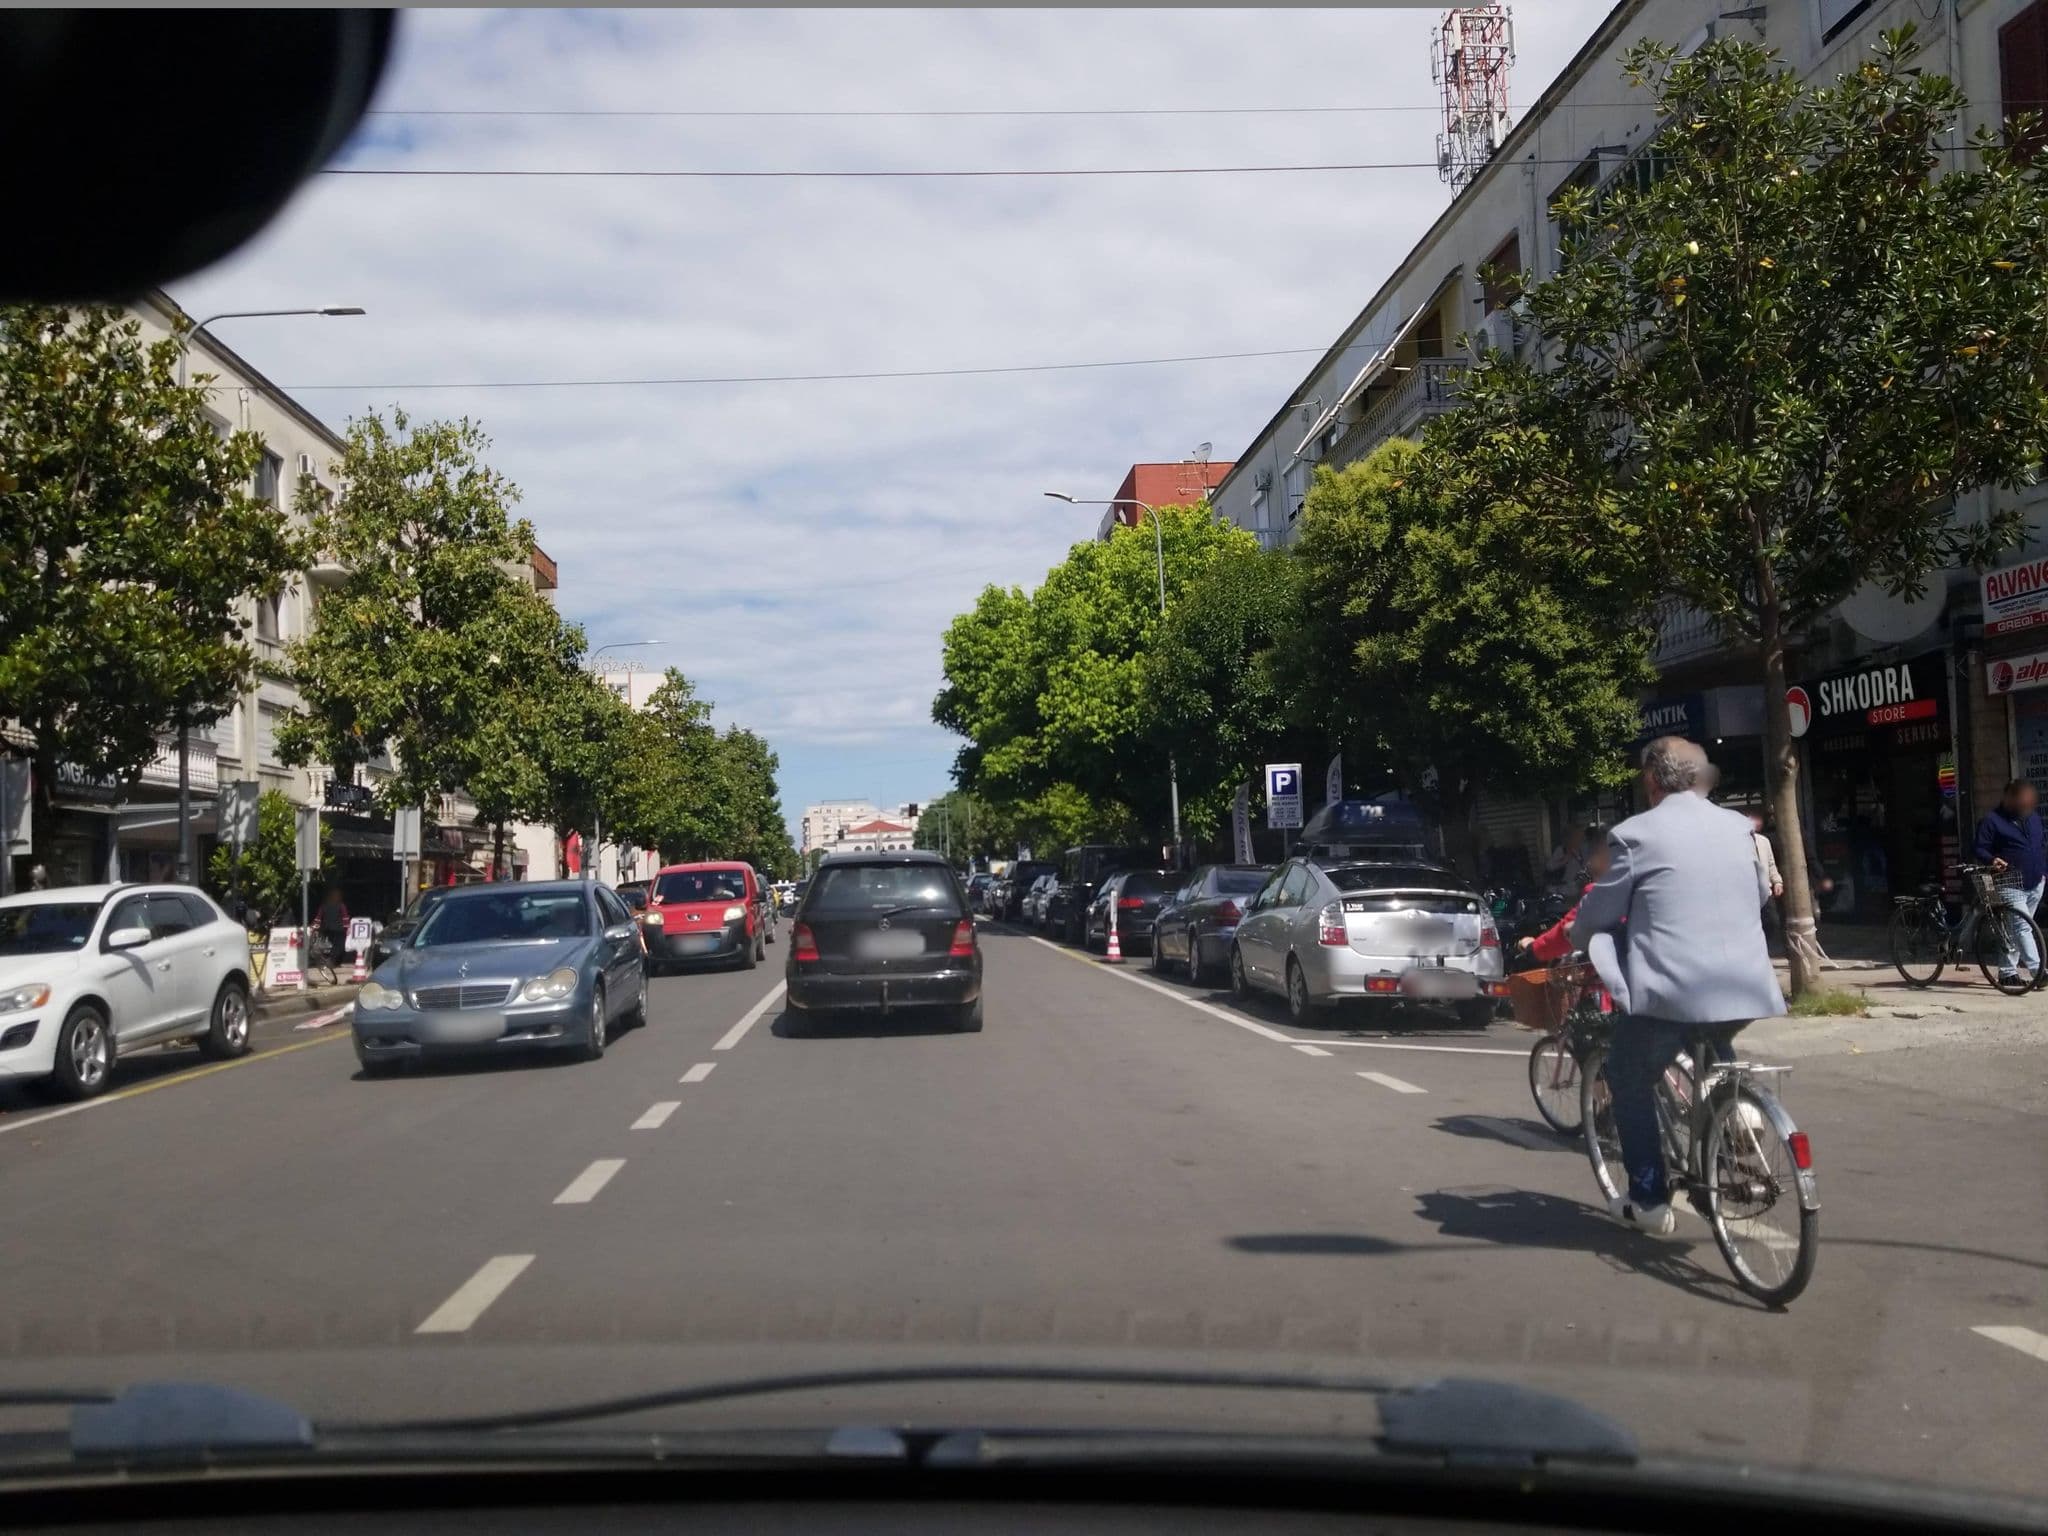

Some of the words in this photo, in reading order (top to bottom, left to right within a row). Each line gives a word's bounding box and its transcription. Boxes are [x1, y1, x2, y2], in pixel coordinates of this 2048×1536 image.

[1819, 664, 1915, 716] SHKODRA
[1872, 706, 1905, 723] STORE
[1276, 772, 1292, 793] P
[358, 925, 366, 937] P
